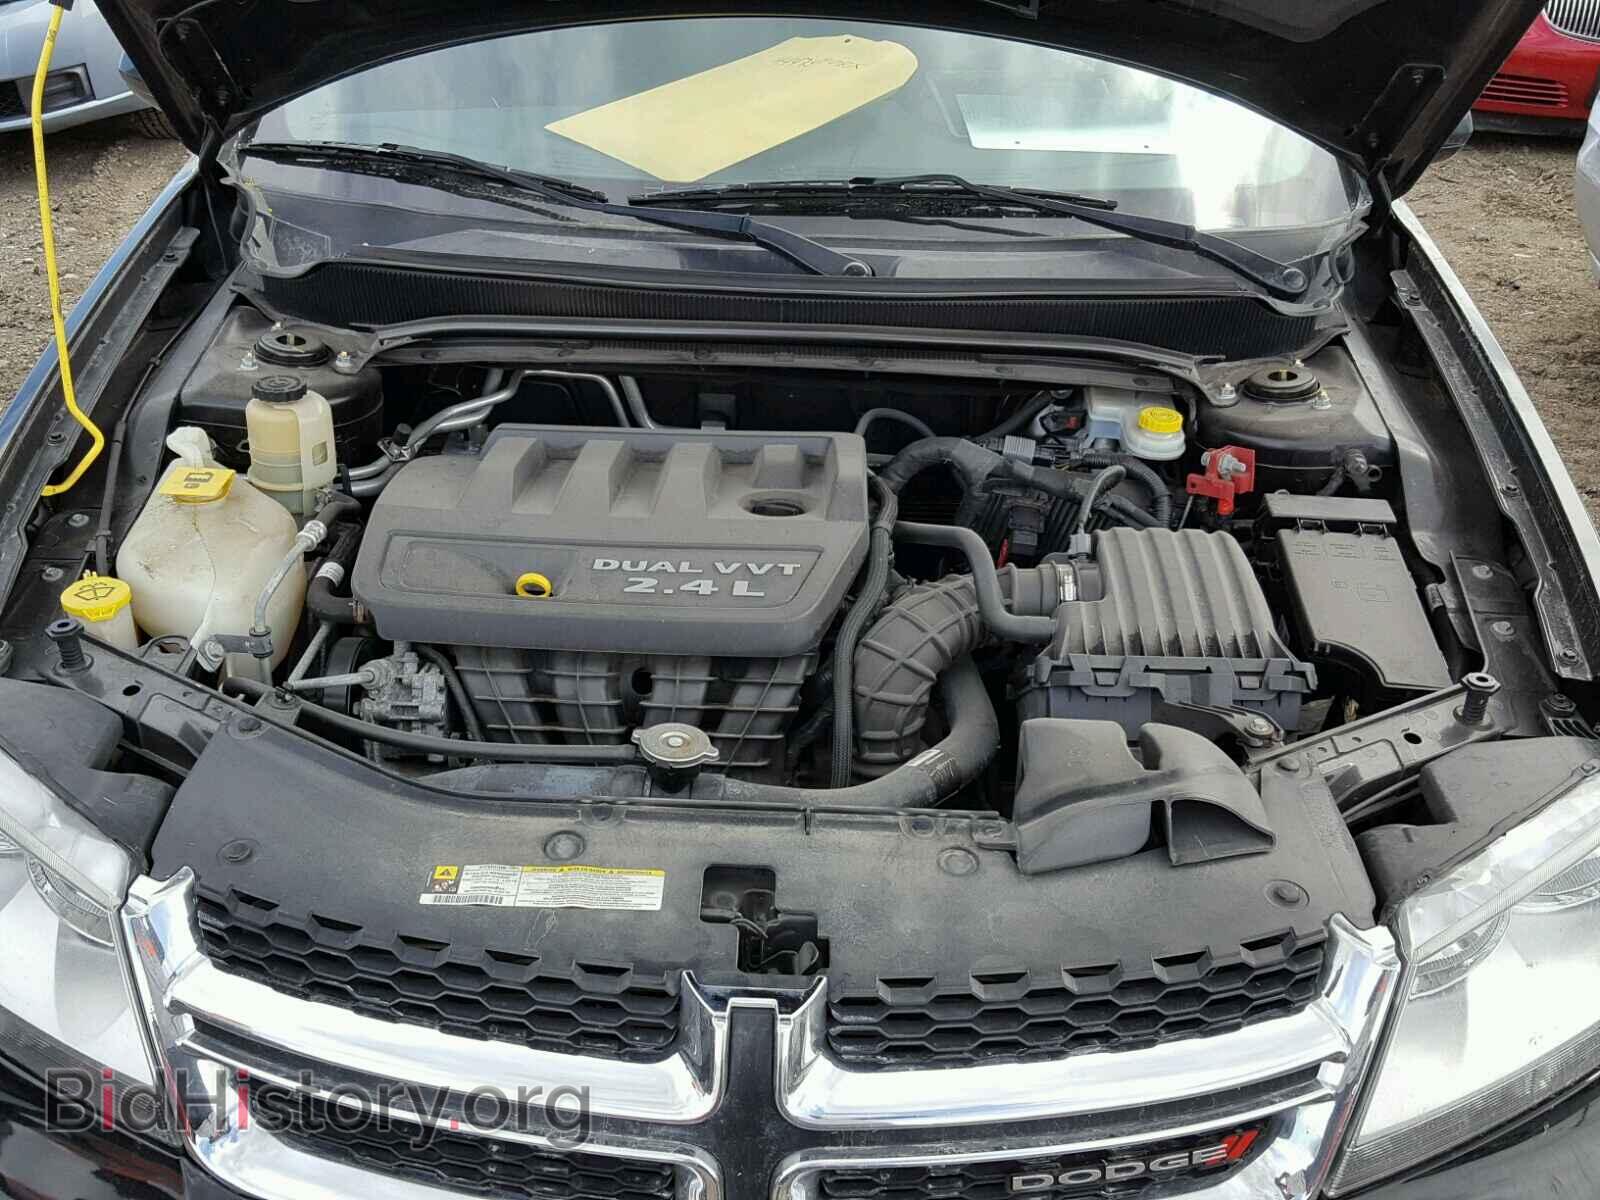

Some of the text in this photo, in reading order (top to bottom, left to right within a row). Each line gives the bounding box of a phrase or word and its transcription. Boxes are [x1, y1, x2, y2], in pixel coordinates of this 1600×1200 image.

[592, 558, 801, 576] DUAL VVT
[1011, 1143, 1229, 1192] DODGE
